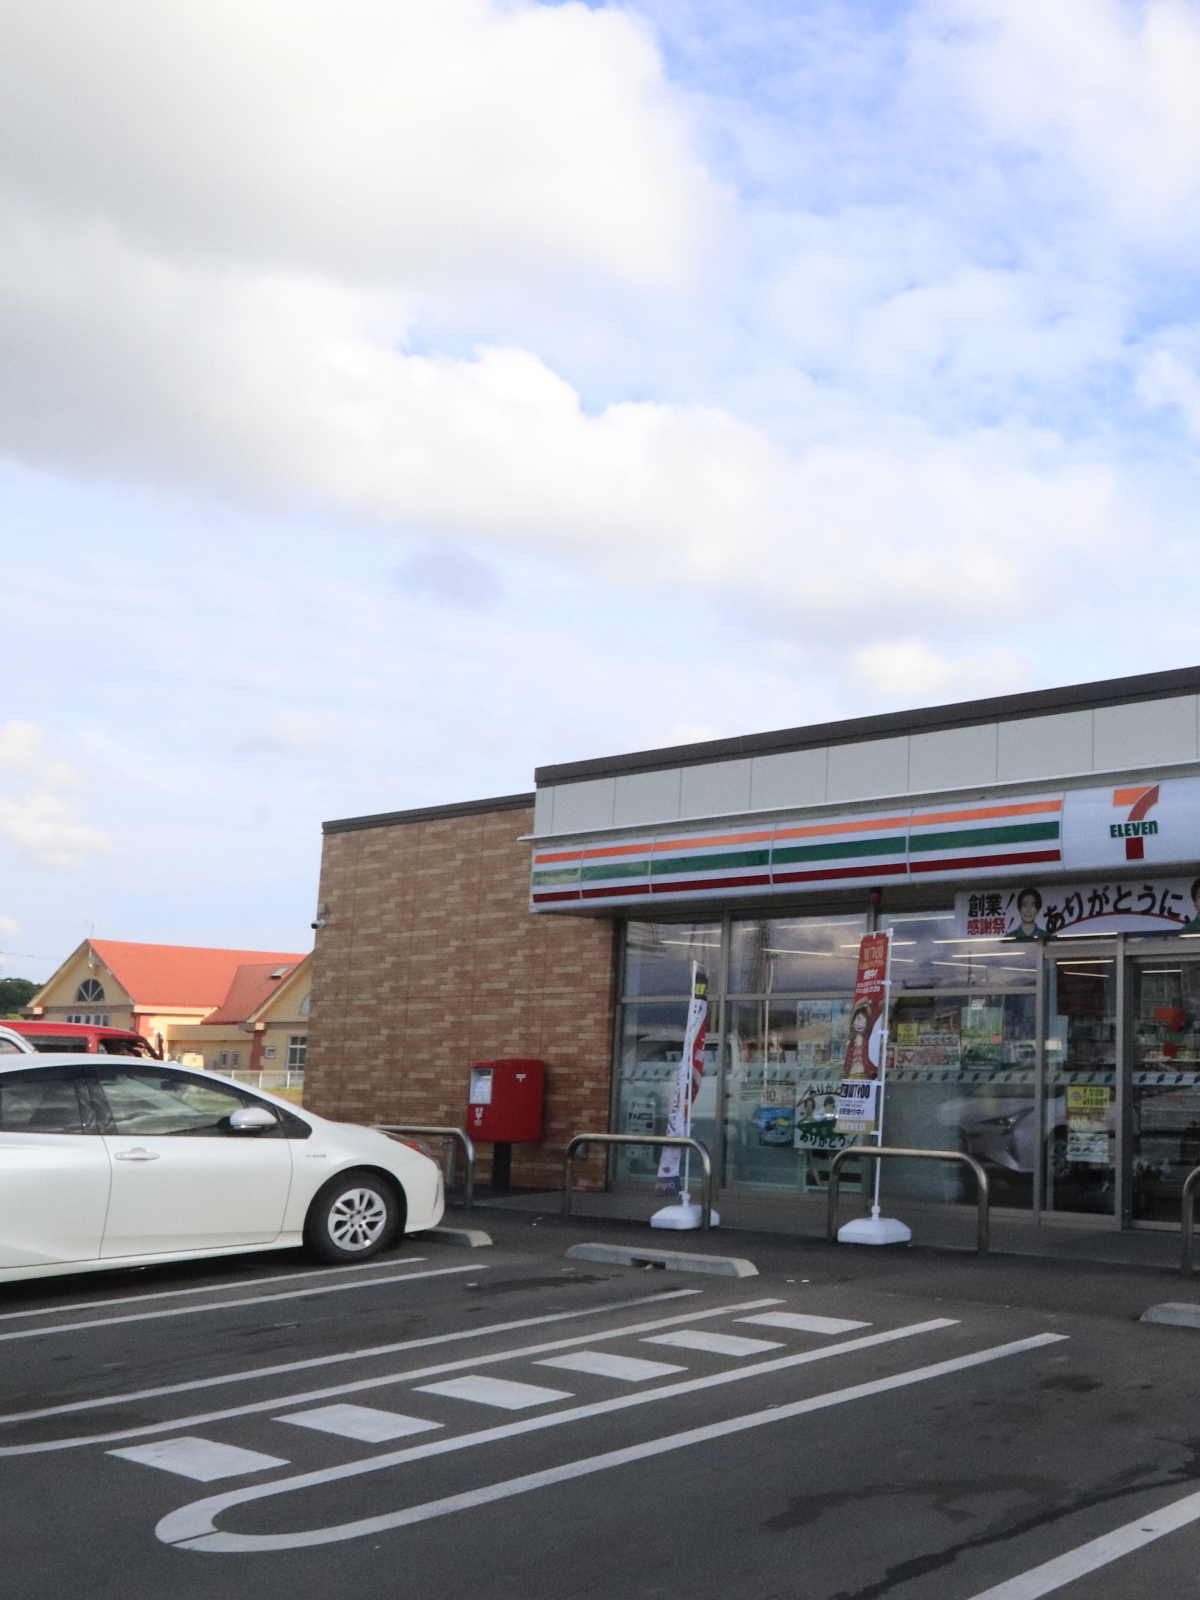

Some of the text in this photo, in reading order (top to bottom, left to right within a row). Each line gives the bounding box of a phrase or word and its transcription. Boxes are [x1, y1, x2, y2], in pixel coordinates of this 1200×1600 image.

[967, 892, 1015, 917] 創業!
[967, 917, 1014, 935] 感謝祭!
